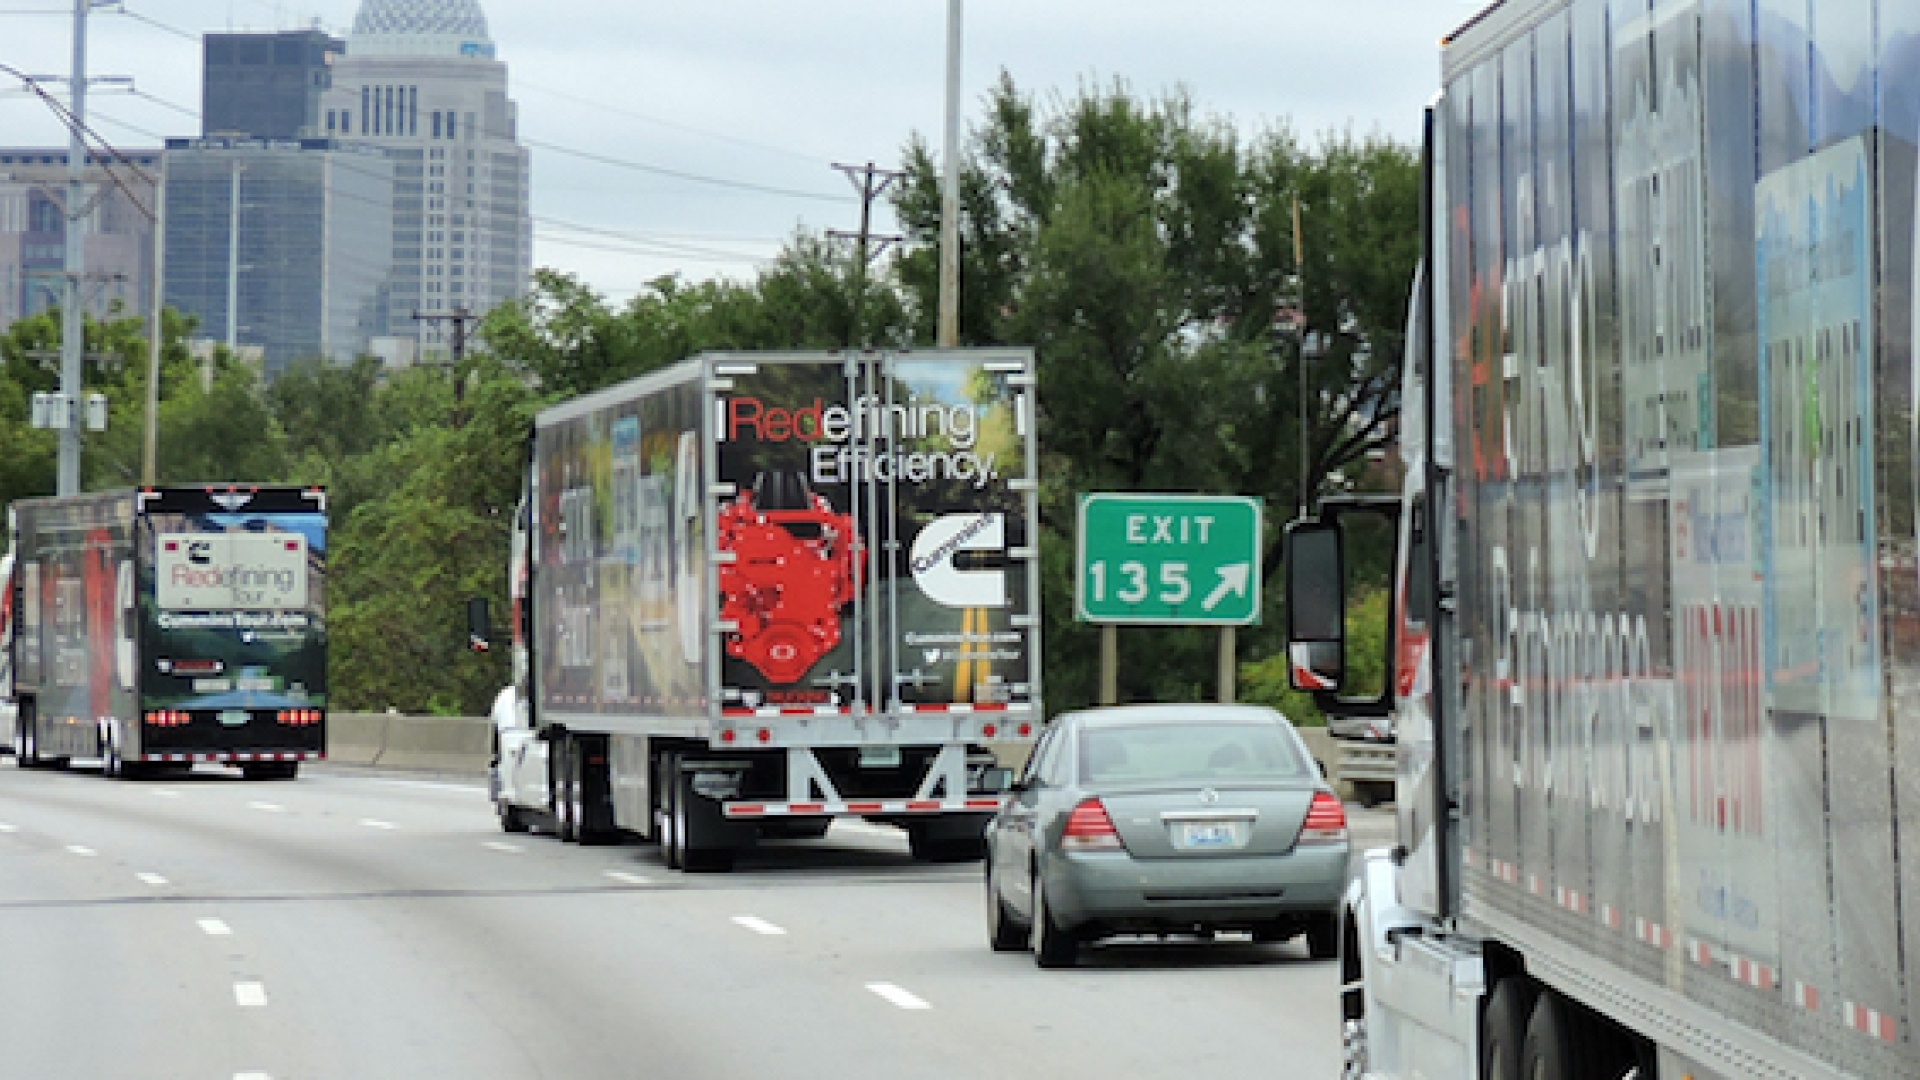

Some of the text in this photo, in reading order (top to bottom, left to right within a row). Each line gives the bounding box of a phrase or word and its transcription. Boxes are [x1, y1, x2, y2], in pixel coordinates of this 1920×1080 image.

[728, 394, 979, 448] Redefining
[911, 512, 996, 573] Cummins
[1126, 513, 1216, 544] EXIT
[171, 564, 295, 593] Redefining
[1089, 560, 1192, 605] 135
